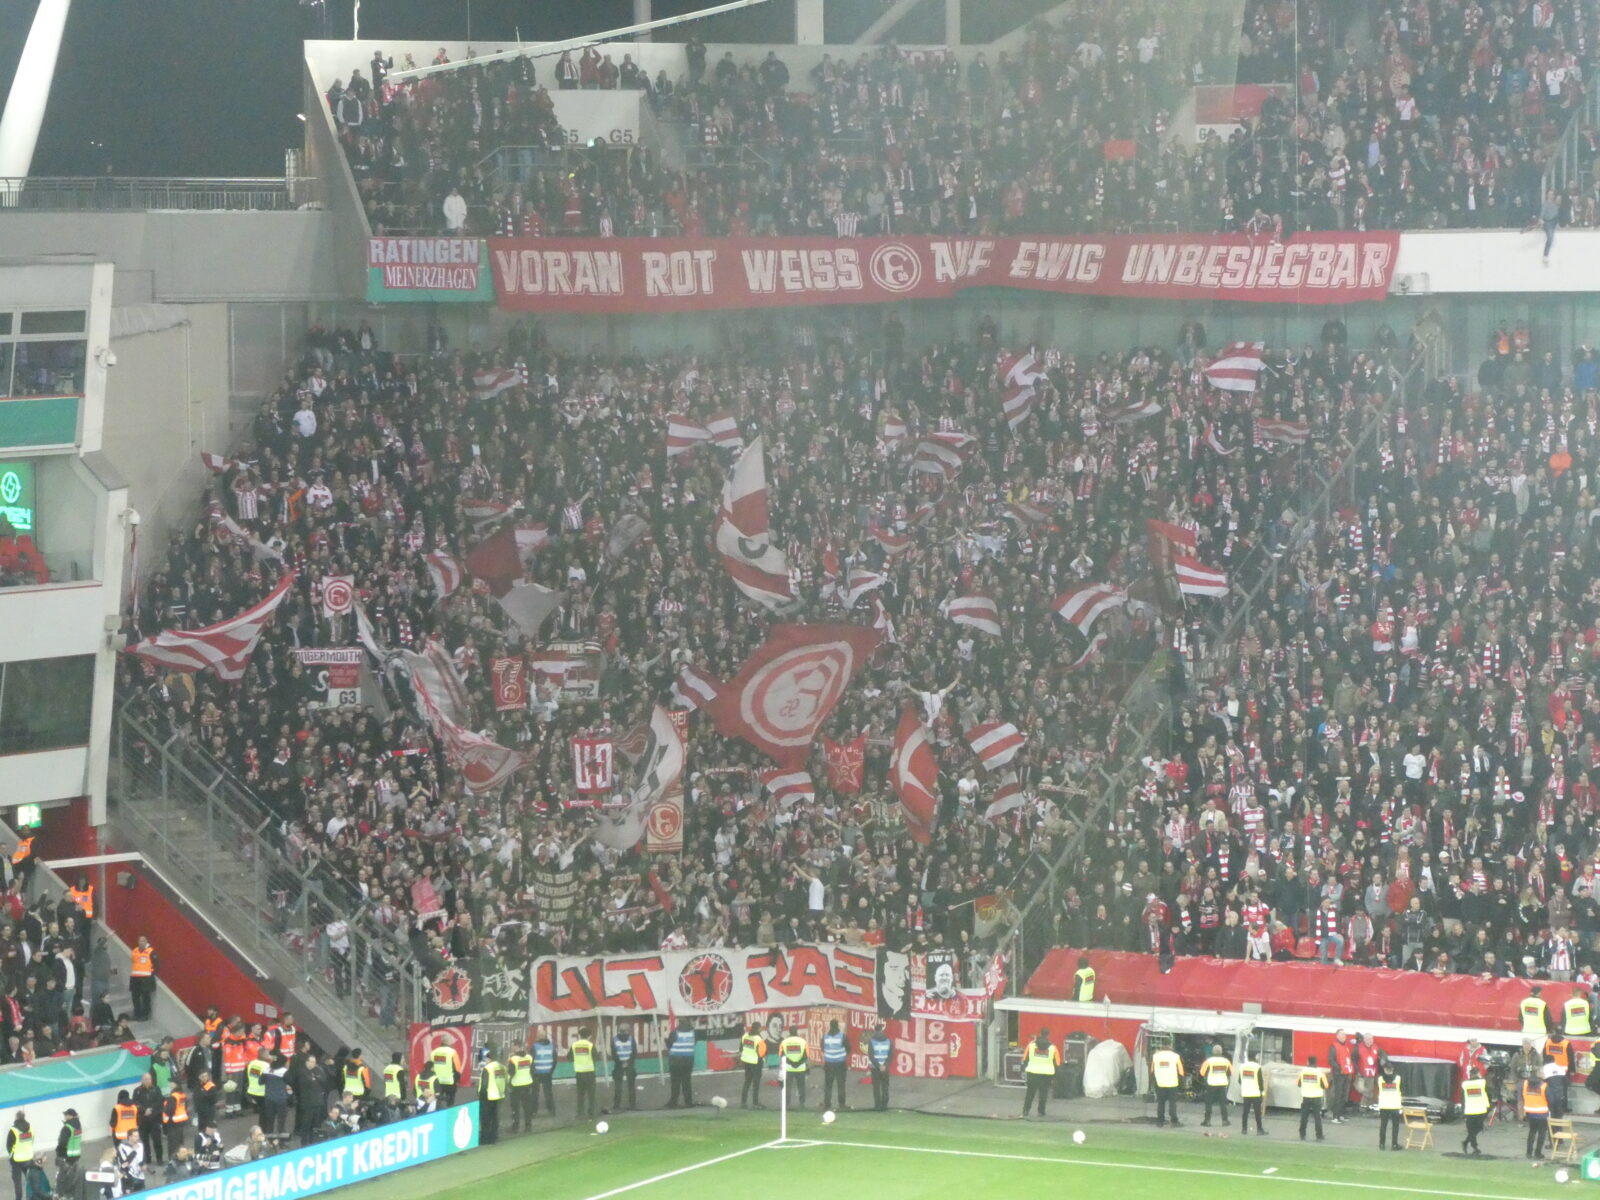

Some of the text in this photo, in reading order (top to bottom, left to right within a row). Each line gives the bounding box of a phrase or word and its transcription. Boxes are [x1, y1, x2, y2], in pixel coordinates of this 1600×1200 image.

[609, 129, 633, 143] G5
[370, 239, 479, 263] RATINGEN
[385, 265, 477, 289] MEINERZHAGEN
[496, 249, 624, 295] VORAN
[642, 250, 717, 296] ROT
[741, 248, 863, 293] WEISS
[1009, 241, 1106, 282] EWIG
[1122, 242, 1392, 288] UNBESIEGBAR
[339, 690, 357, 704] G3
[1364, 1067, 1376, 1077] TV
[225, 1148, 348, 1200] GEMACHT
[353, 1122, 434, 1174] KREDIT
